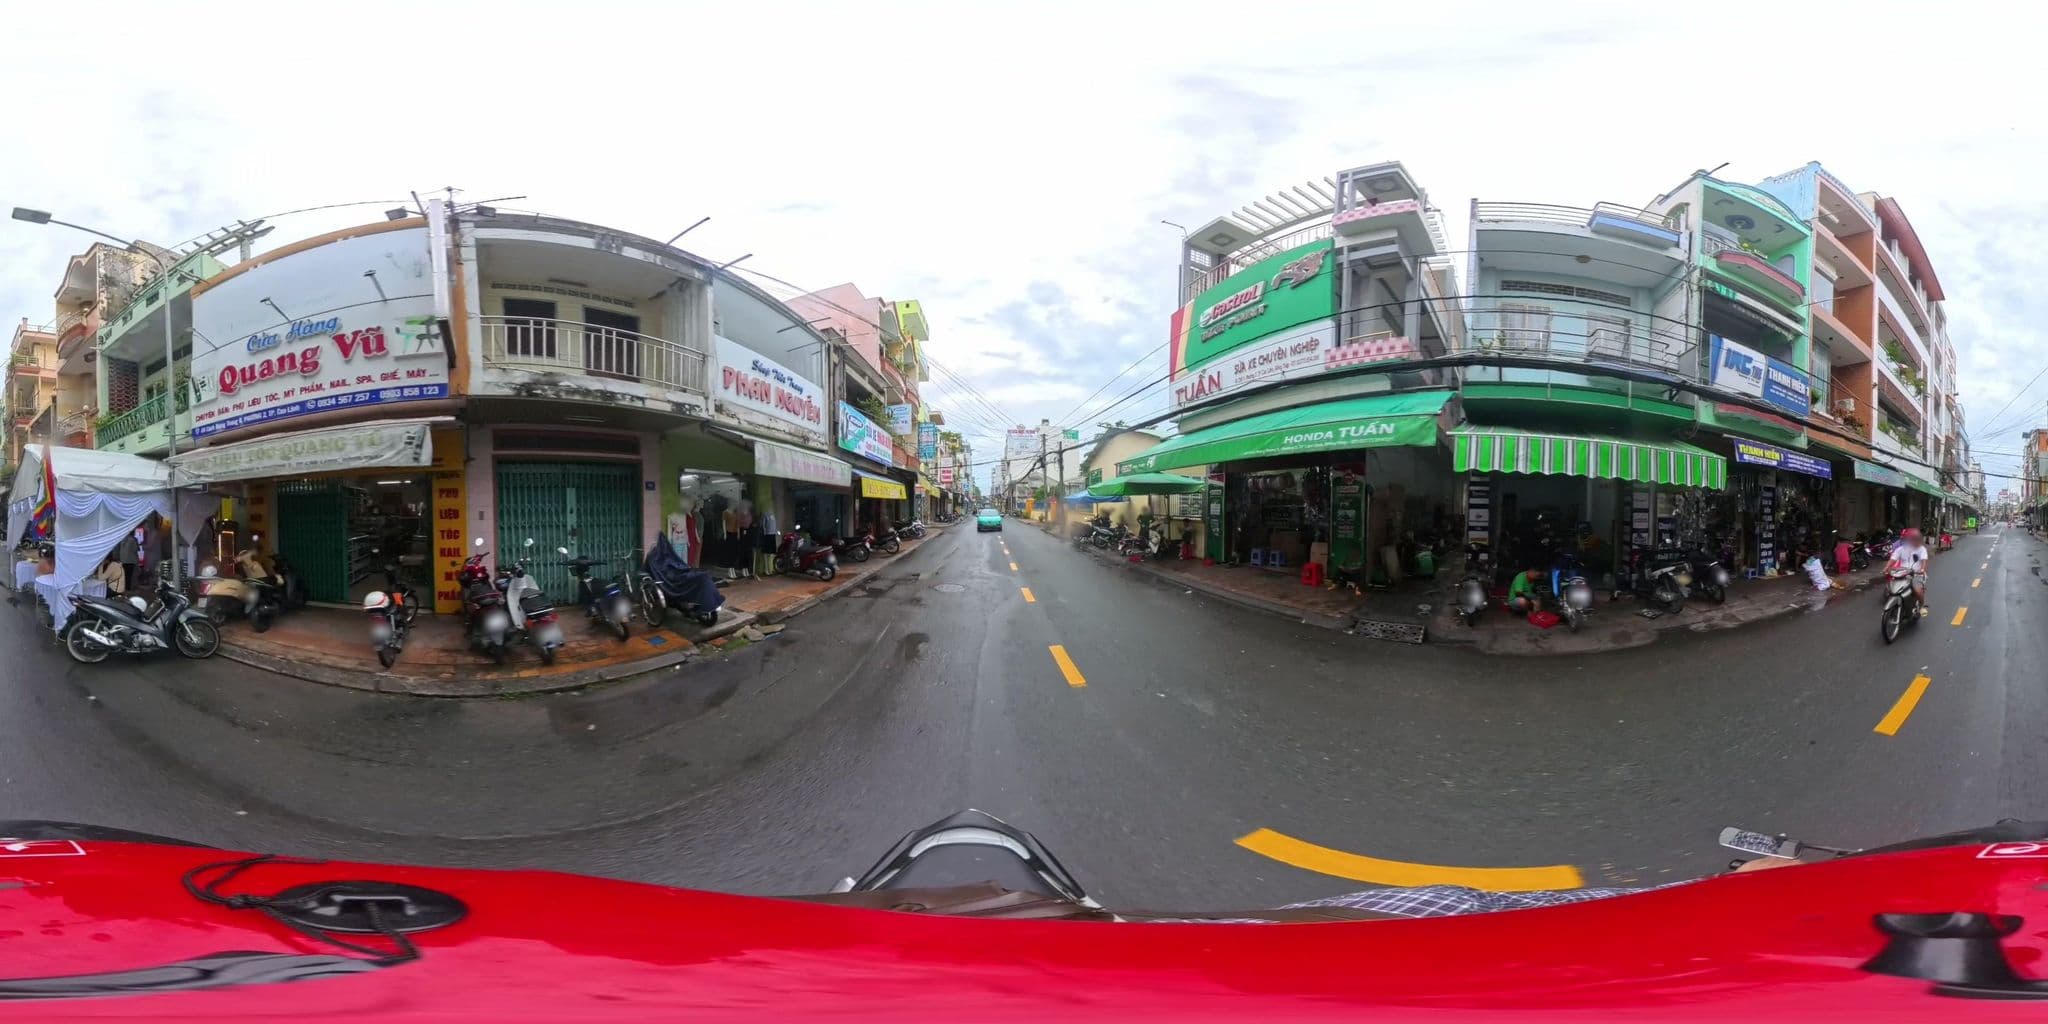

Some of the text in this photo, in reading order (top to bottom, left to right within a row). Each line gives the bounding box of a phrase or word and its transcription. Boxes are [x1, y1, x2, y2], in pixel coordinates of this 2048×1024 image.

[285, 317, 338, 343] Hàng
[219, 327, 386, 395] Quang Vũ
[1258, 346, 1287, 367] CHUYÊN
[1290, 336, 1320, 354] NGHIỆP
[722, 366, 772, 404] PHAN
[1175, 370, 1222, 406] TUẤN
[1283, 420, 1396, 445] HONDA TUẤN
